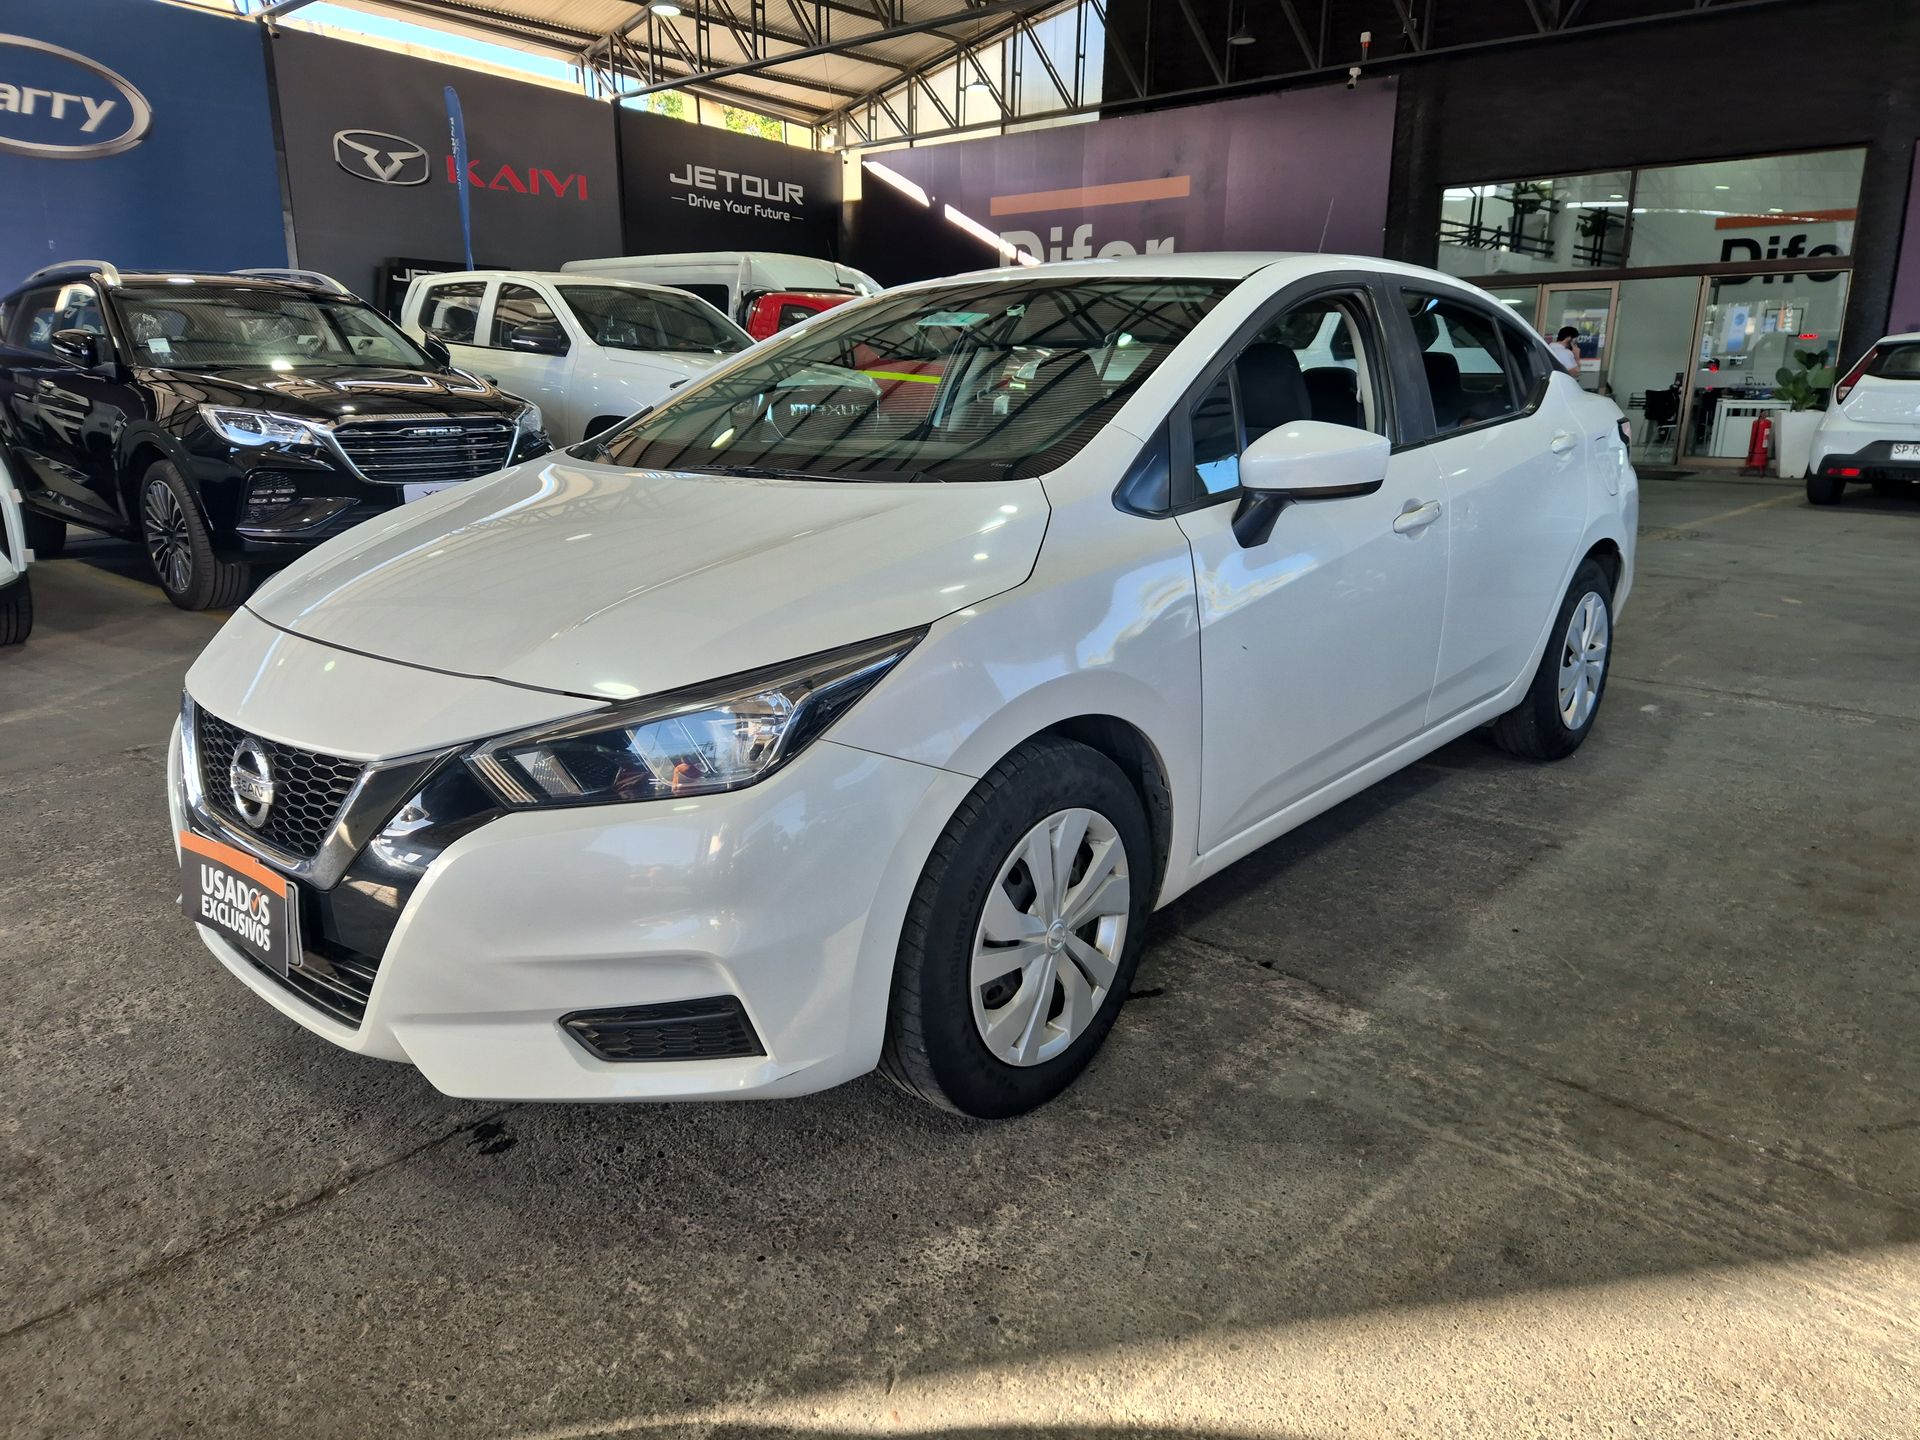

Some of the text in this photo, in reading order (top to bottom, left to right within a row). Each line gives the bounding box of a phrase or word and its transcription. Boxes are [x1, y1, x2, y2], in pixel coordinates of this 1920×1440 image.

[446, 155, 589, 201] KAIYI
[669, 163, 804, 206] JETOUR
[688, 193, 791, 222] Drive Your Future
[201, 863, 270, 926] USADOS
[201, 894, 271, 952] EXCLUSIVOS
